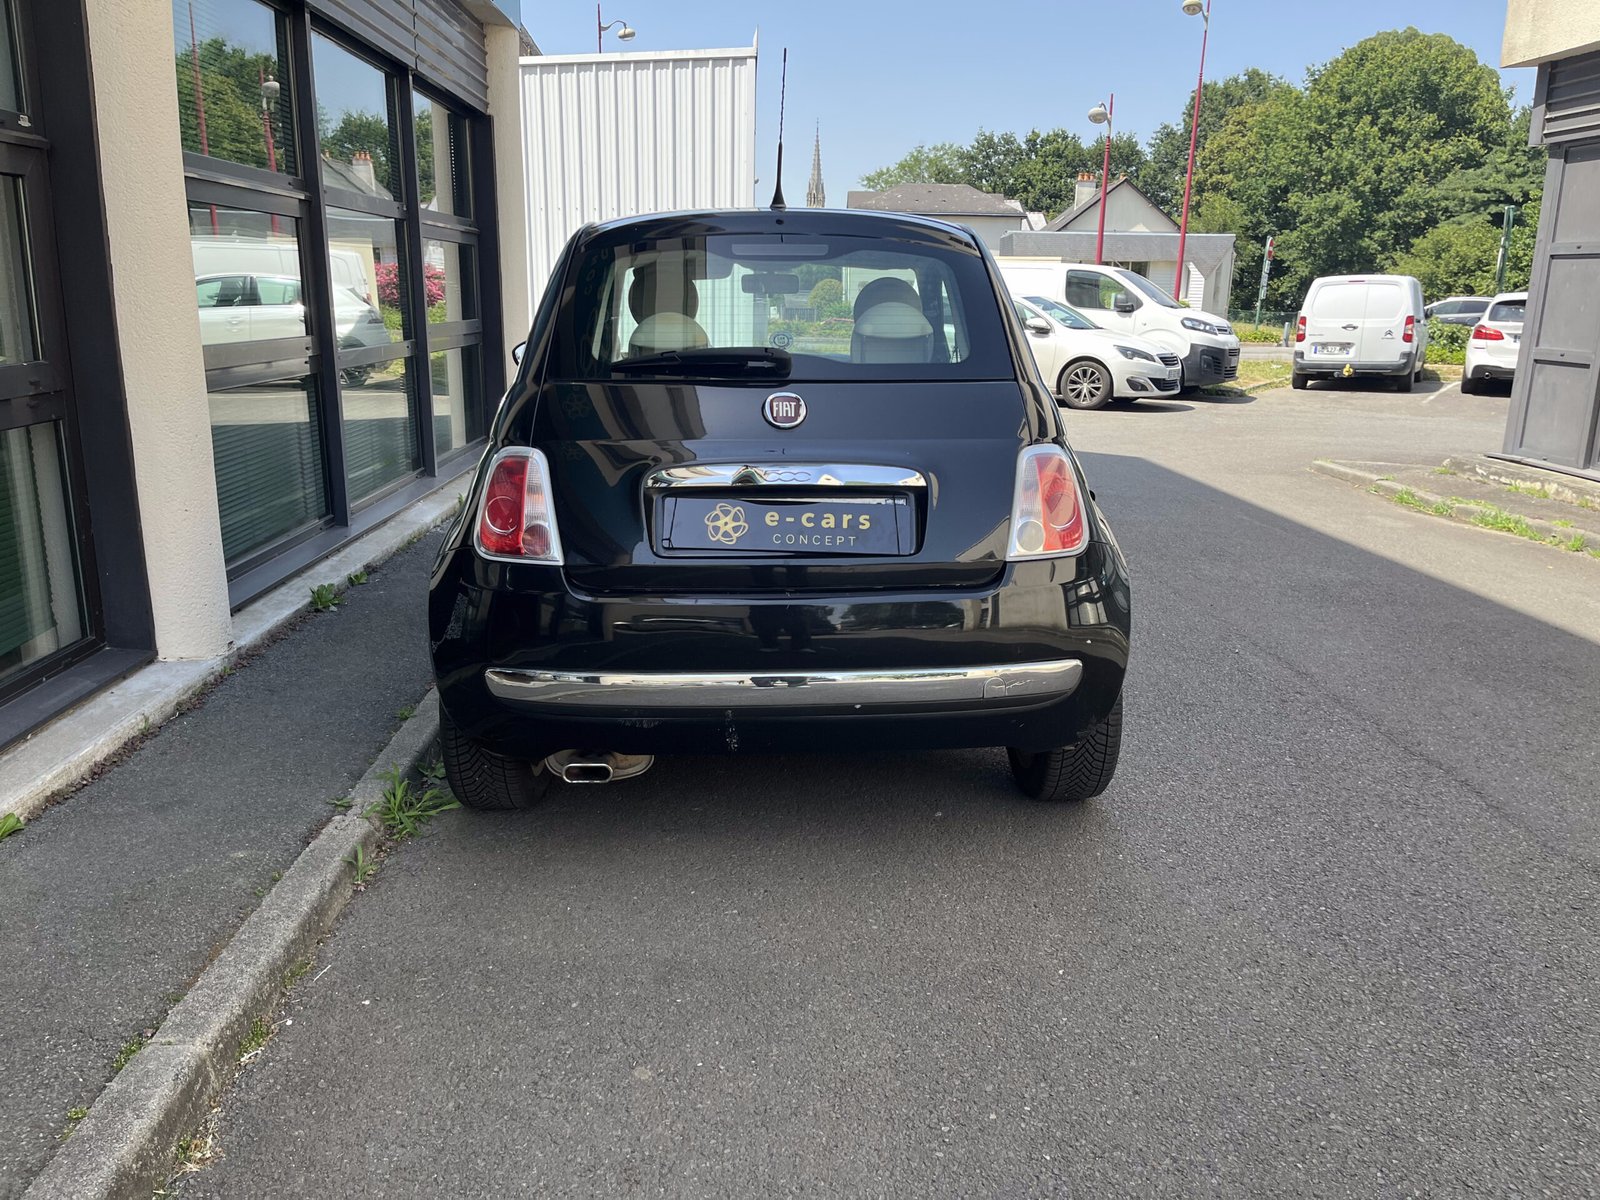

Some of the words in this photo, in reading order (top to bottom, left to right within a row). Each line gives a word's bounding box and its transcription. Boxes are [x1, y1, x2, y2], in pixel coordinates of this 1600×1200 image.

[773, 402, 796, 417] FIAT
[765, 511, 871, 529] e-cars
[773, 534, 856, 546] CONCEPT
